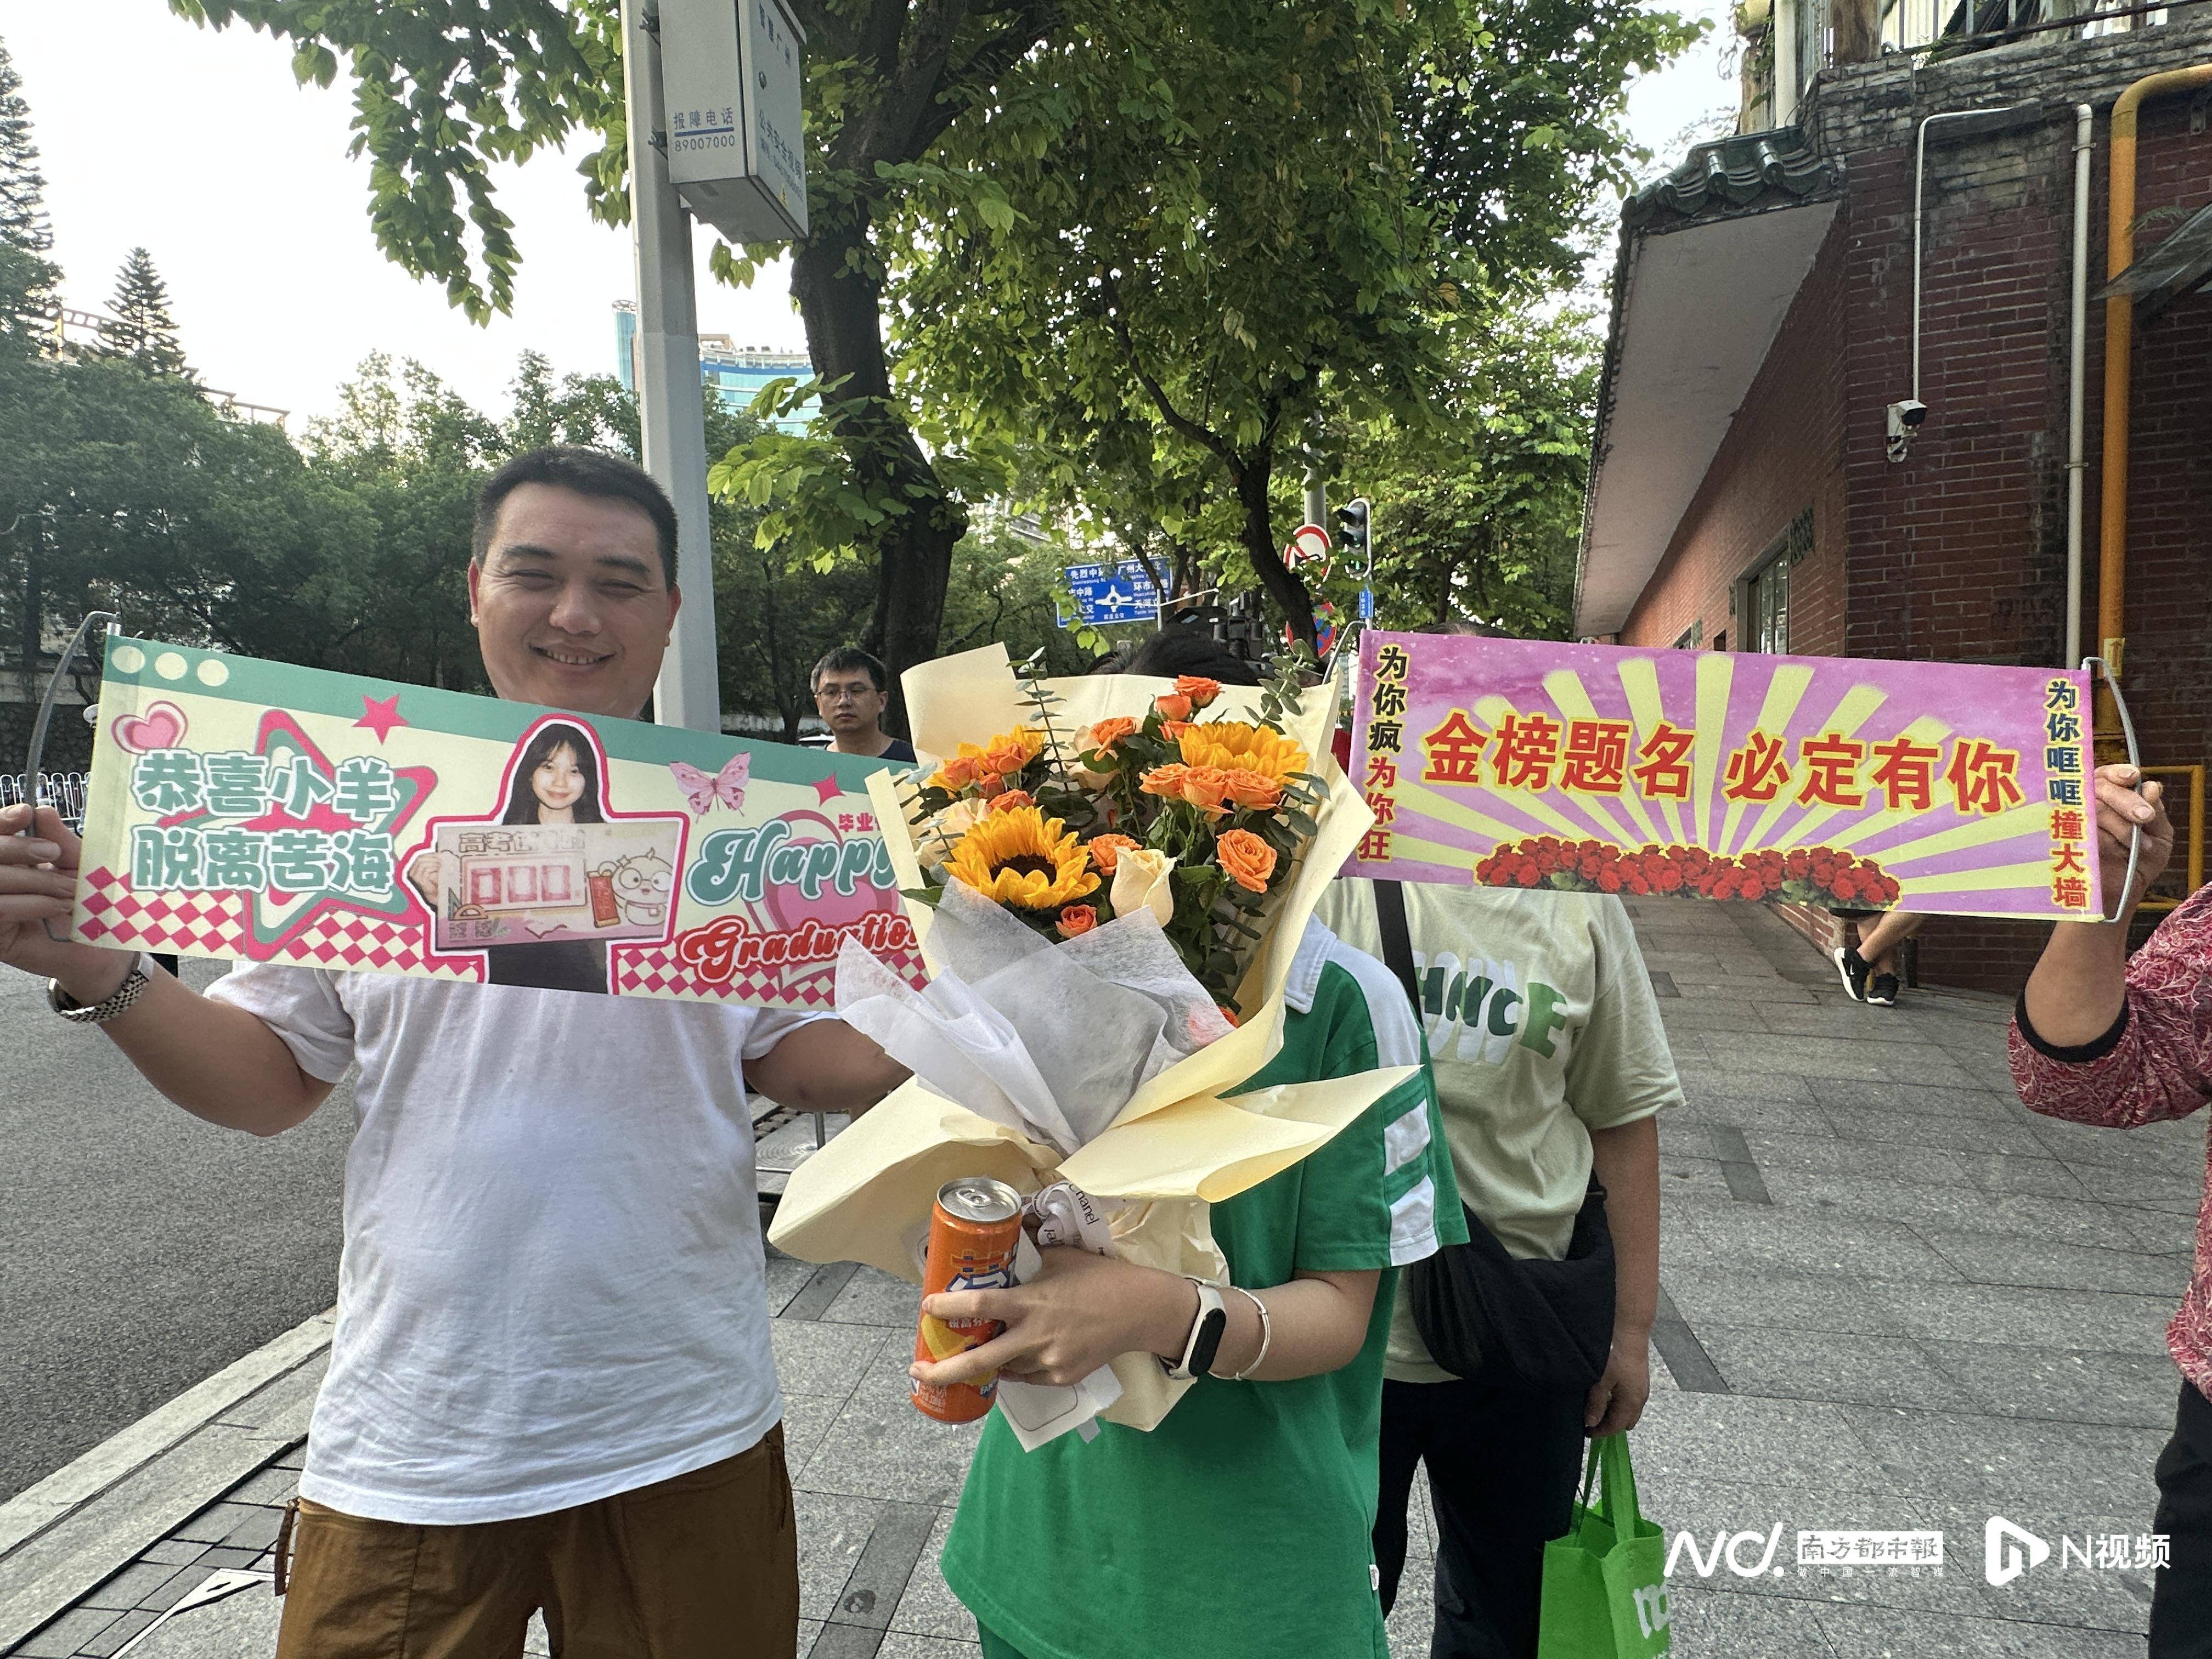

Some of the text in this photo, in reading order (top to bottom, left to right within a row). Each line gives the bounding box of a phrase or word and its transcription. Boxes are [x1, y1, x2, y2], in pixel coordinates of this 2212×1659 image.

[673, 107, 733, 129] 报障电话
[675, 135, 735, 151] 89007000
[1133, 578, 1169, 591] 环市路
[131, 748, 397, 821] 恭喜小羊
[1357, 646, 1407, 860] 为你疯为你狂
[1424, 712, 2025, 813] 金榜题名 必定有你
[838, 812, 881, 833] 毕业
[2047, 680, 2087, 907] 为你哐哐撞大墙
[130, 825, 395, 893] 脱离苦海
